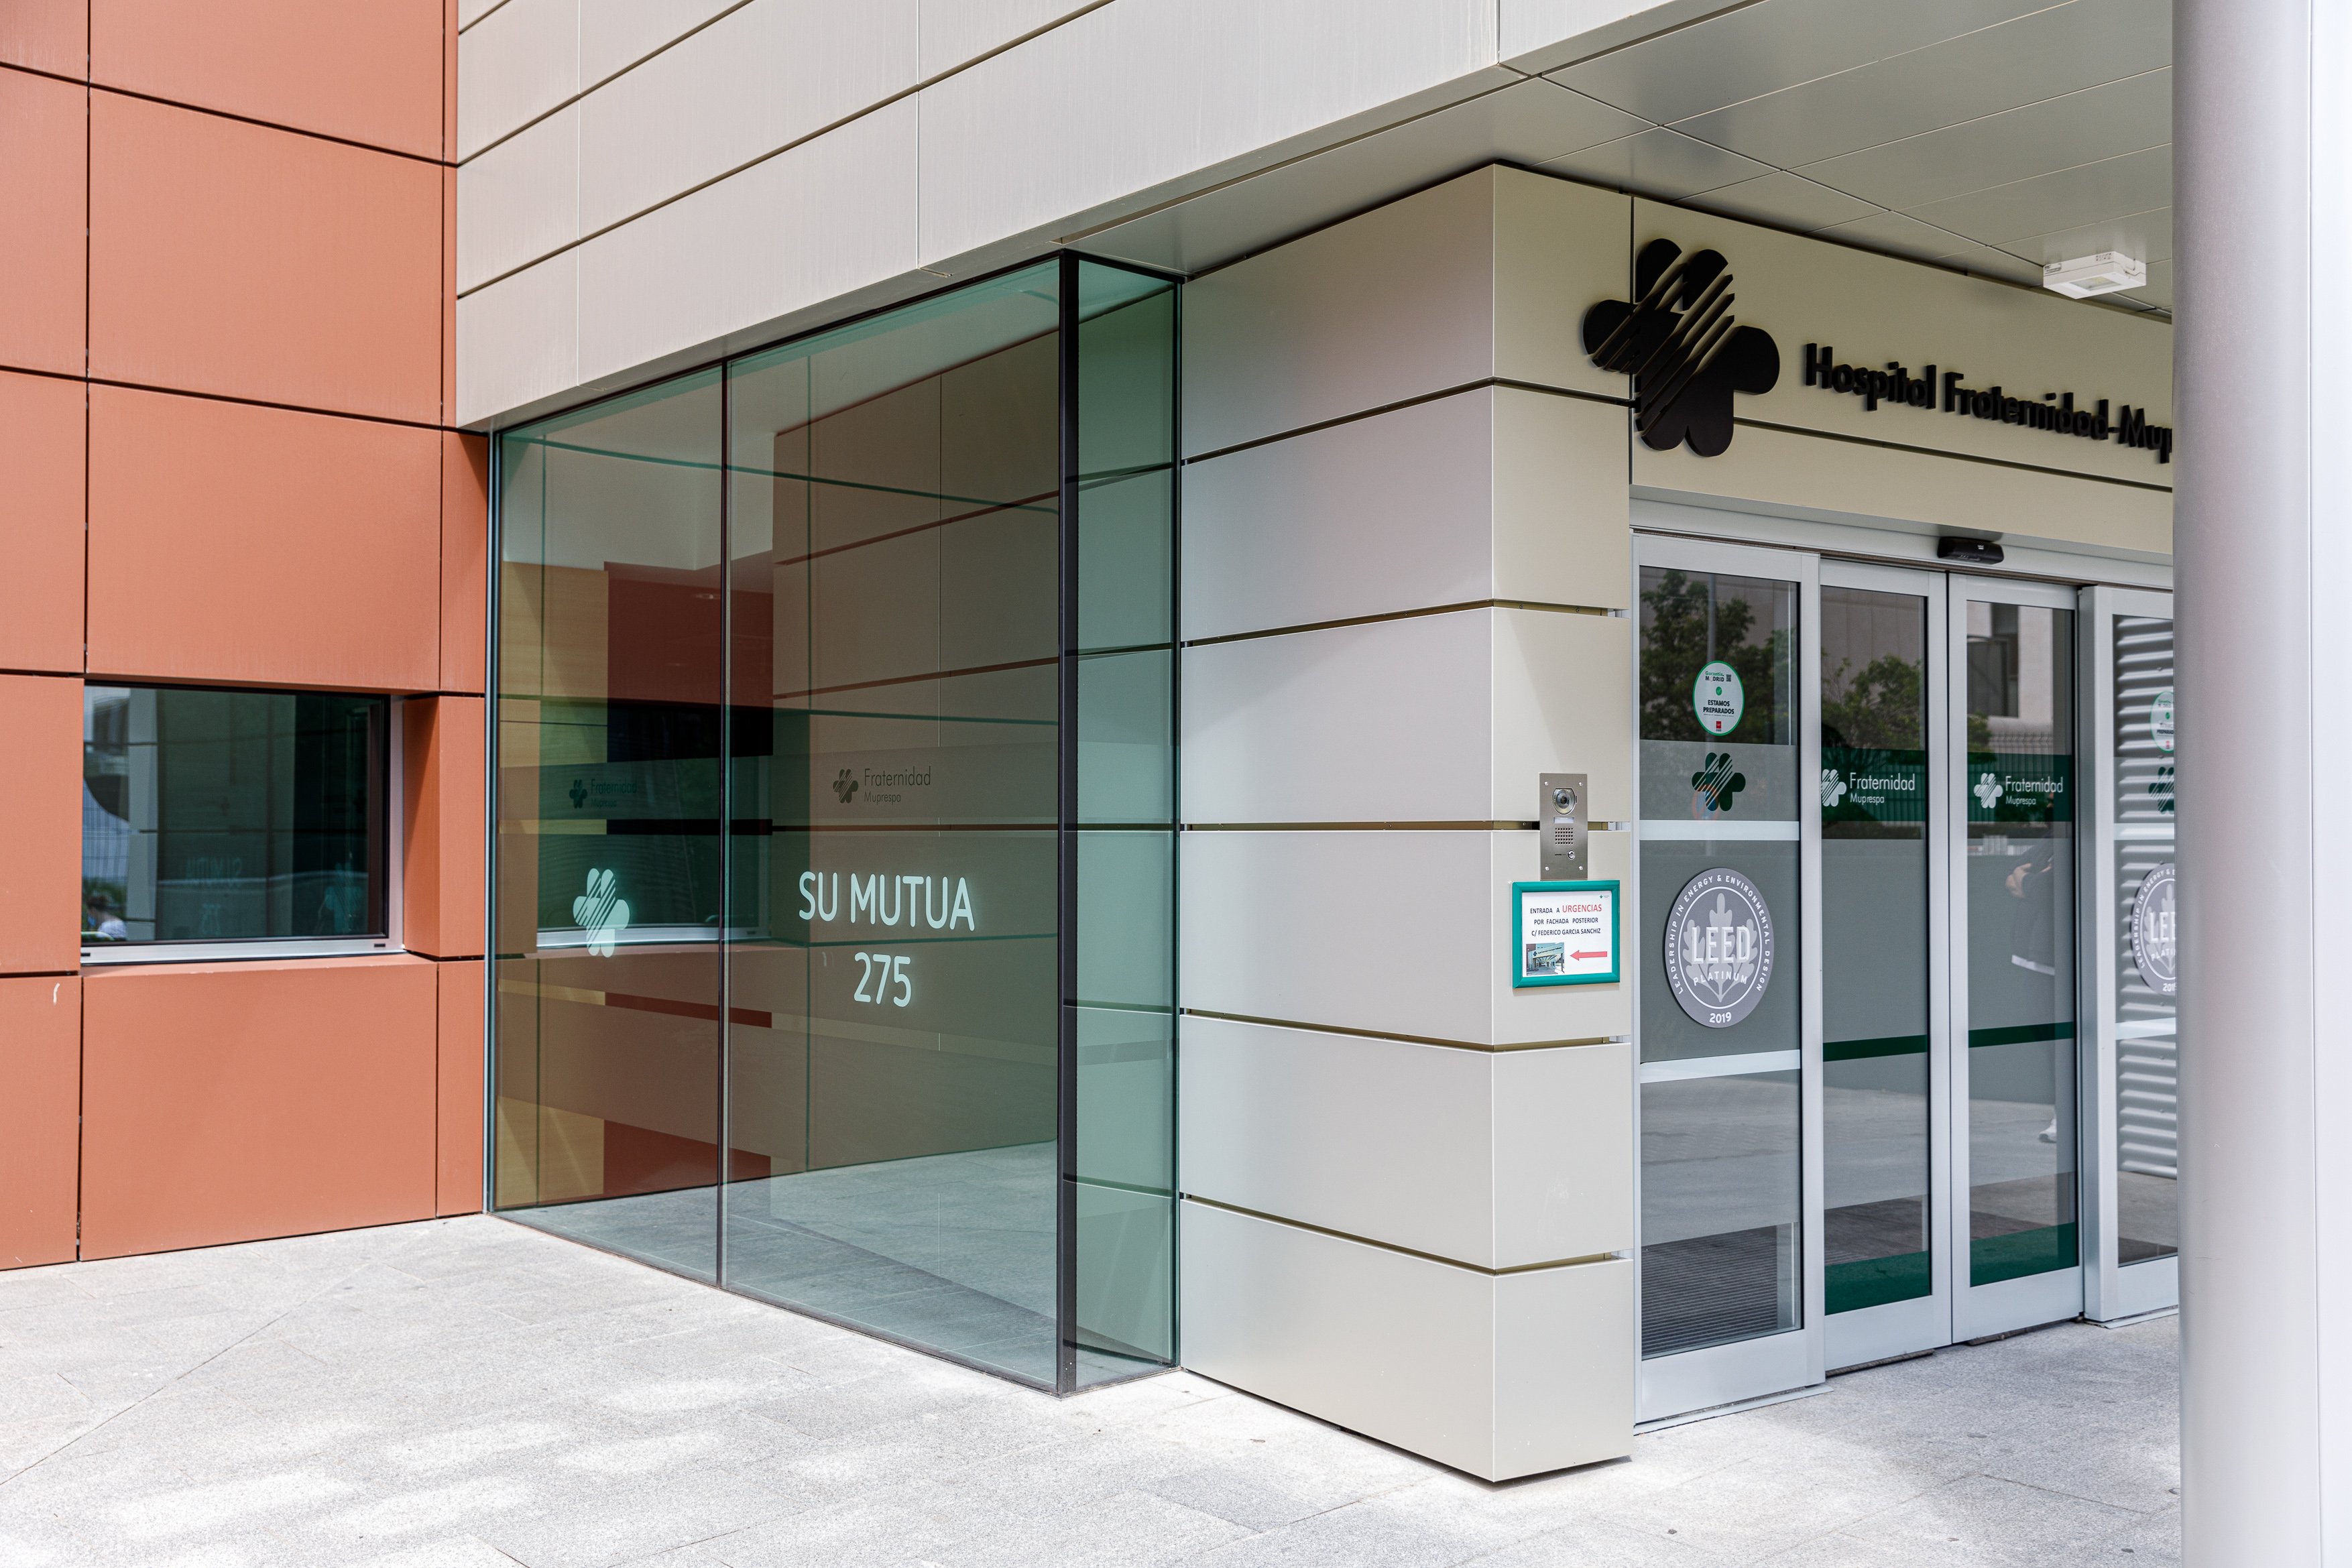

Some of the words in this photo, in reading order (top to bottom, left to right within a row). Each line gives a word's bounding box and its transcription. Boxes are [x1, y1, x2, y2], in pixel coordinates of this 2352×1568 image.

[1805, 343, 1937, 412] Hospital
[1944, 371, 2172, 464] Fraternidad-Mup
[1703, 707, 1734, 715] PREPARADOS
[864, 766, 931, 786] Fraternidad
[1850, 772, 1916, 791] Fraternidad
[2005, 775, 2064, 793] Fraternidad
[864, 792, 902, 805] Muprespa
[1850, 793, 1885, 805] Muprespa
[2005, 795, 2037, 806] Muprespa
[1717, 874, 1722, 882] &
[2143, 870, 2164, 892] ENERGY
[1684, 876, 1713, 902] ENERGY
[799, 871, 838, 922] SU
[850, 873, 976, 931] MUTUA
[1562, 904, 1602, 913] URGENCIAS
[2137, 894, 2144, 905] IN
[1675, 904, 1684, 916] IN
[1726, 875, 1771, 945] ENVIRONMENTAL
[1691, 925, 1751, 964] LEED
[2133, 908, 2145, 969] LEADERSHIP
[1669, 920, 1684, 995] LEADERSHIP
[2151, 948, 2175, 961] PLATI
[854, 952, 912, 1008] 275
[1693, 971, 1748, 986] PLATINUM
[1756, 951, 1771, 992] DESIGN
[2162, 983, 2175, 992] 201
[1709, 1012, 1732, 1024] 2019
